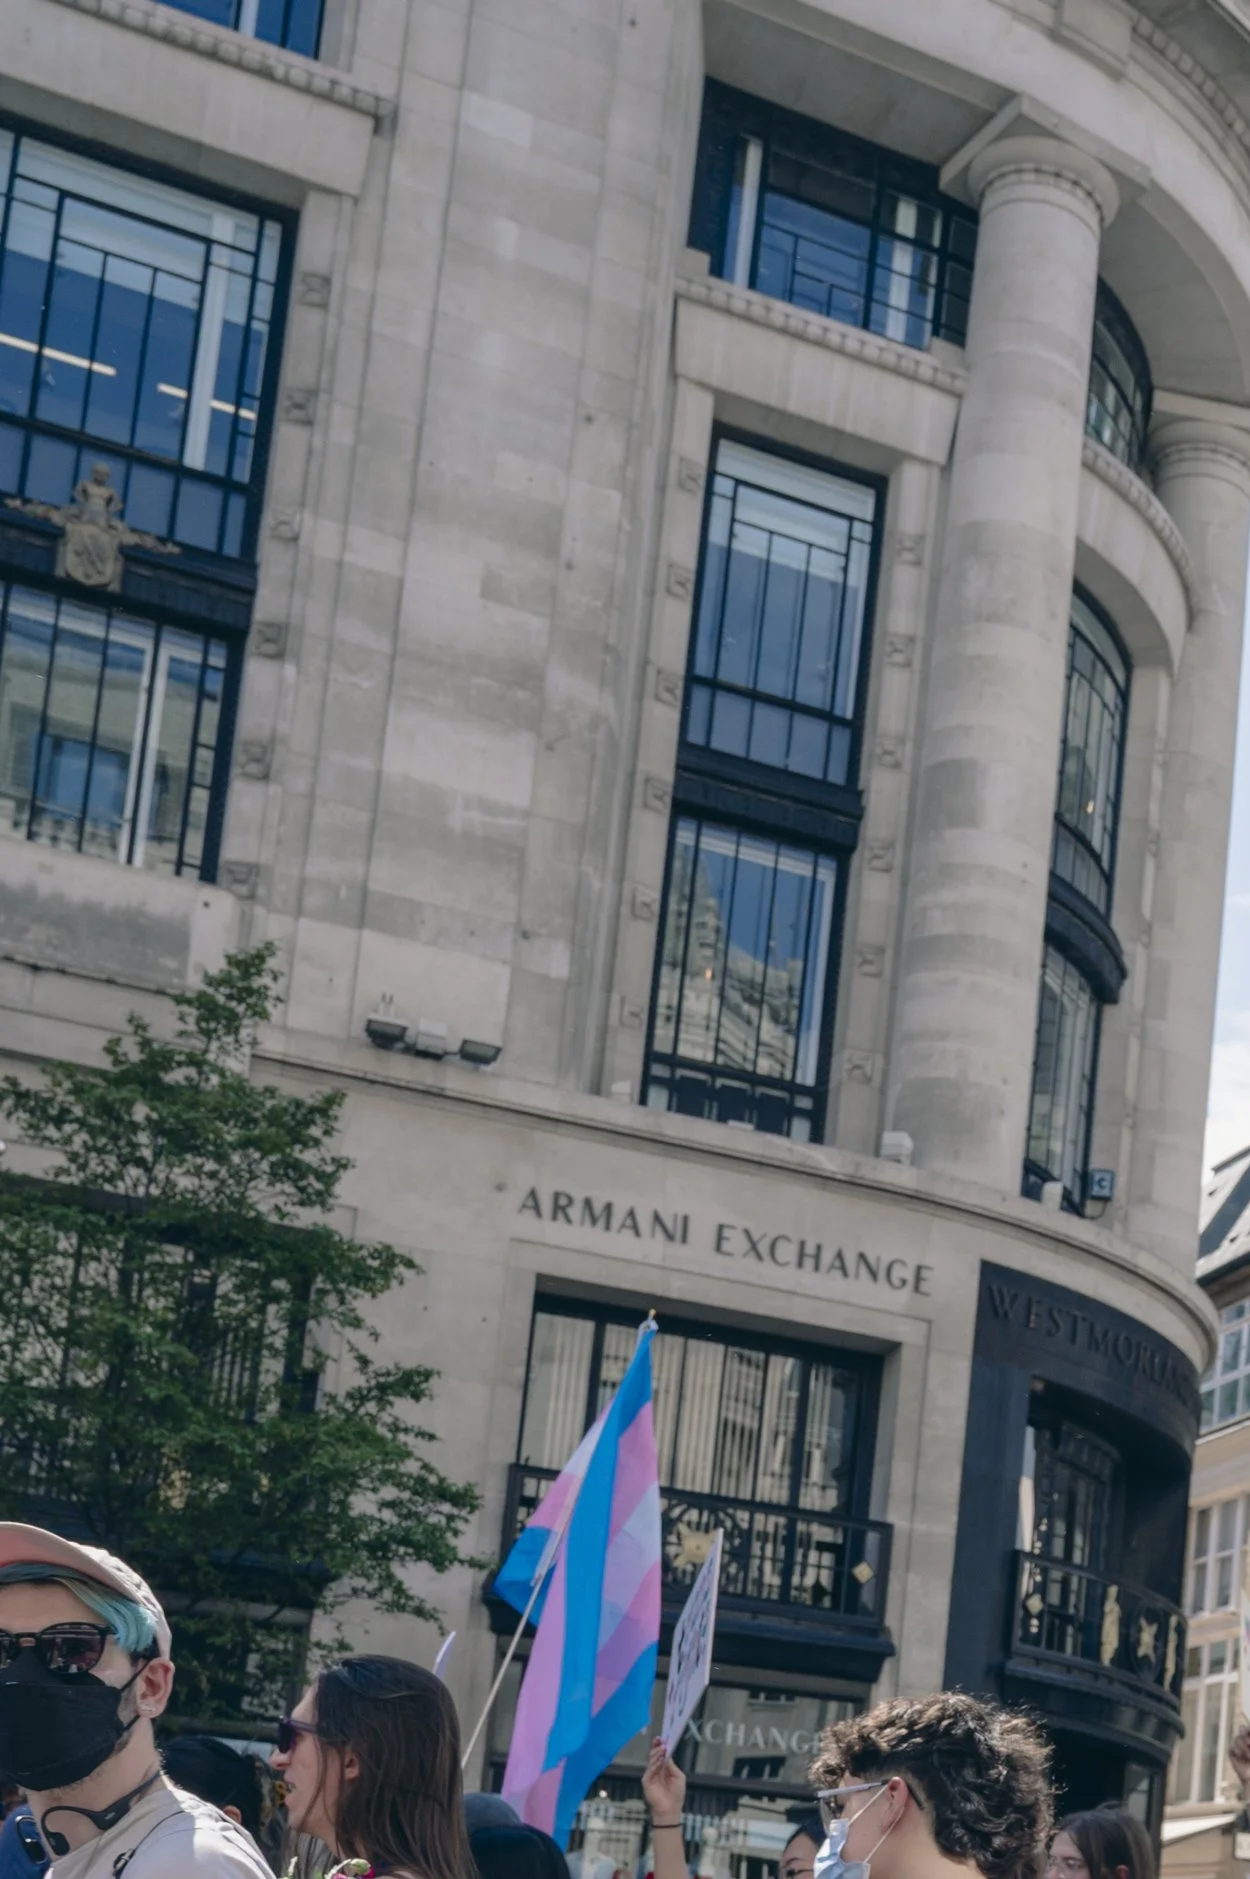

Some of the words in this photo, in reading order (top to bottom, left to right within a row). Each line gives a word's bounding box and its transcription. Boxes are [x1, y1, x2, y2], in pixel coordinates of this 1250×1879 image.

[517, 1186, 690, 1246] ARMANI
[715, 1223, 935, 1298] EXCHANGE
[684, 1717, 822, 1755] XCHANG
